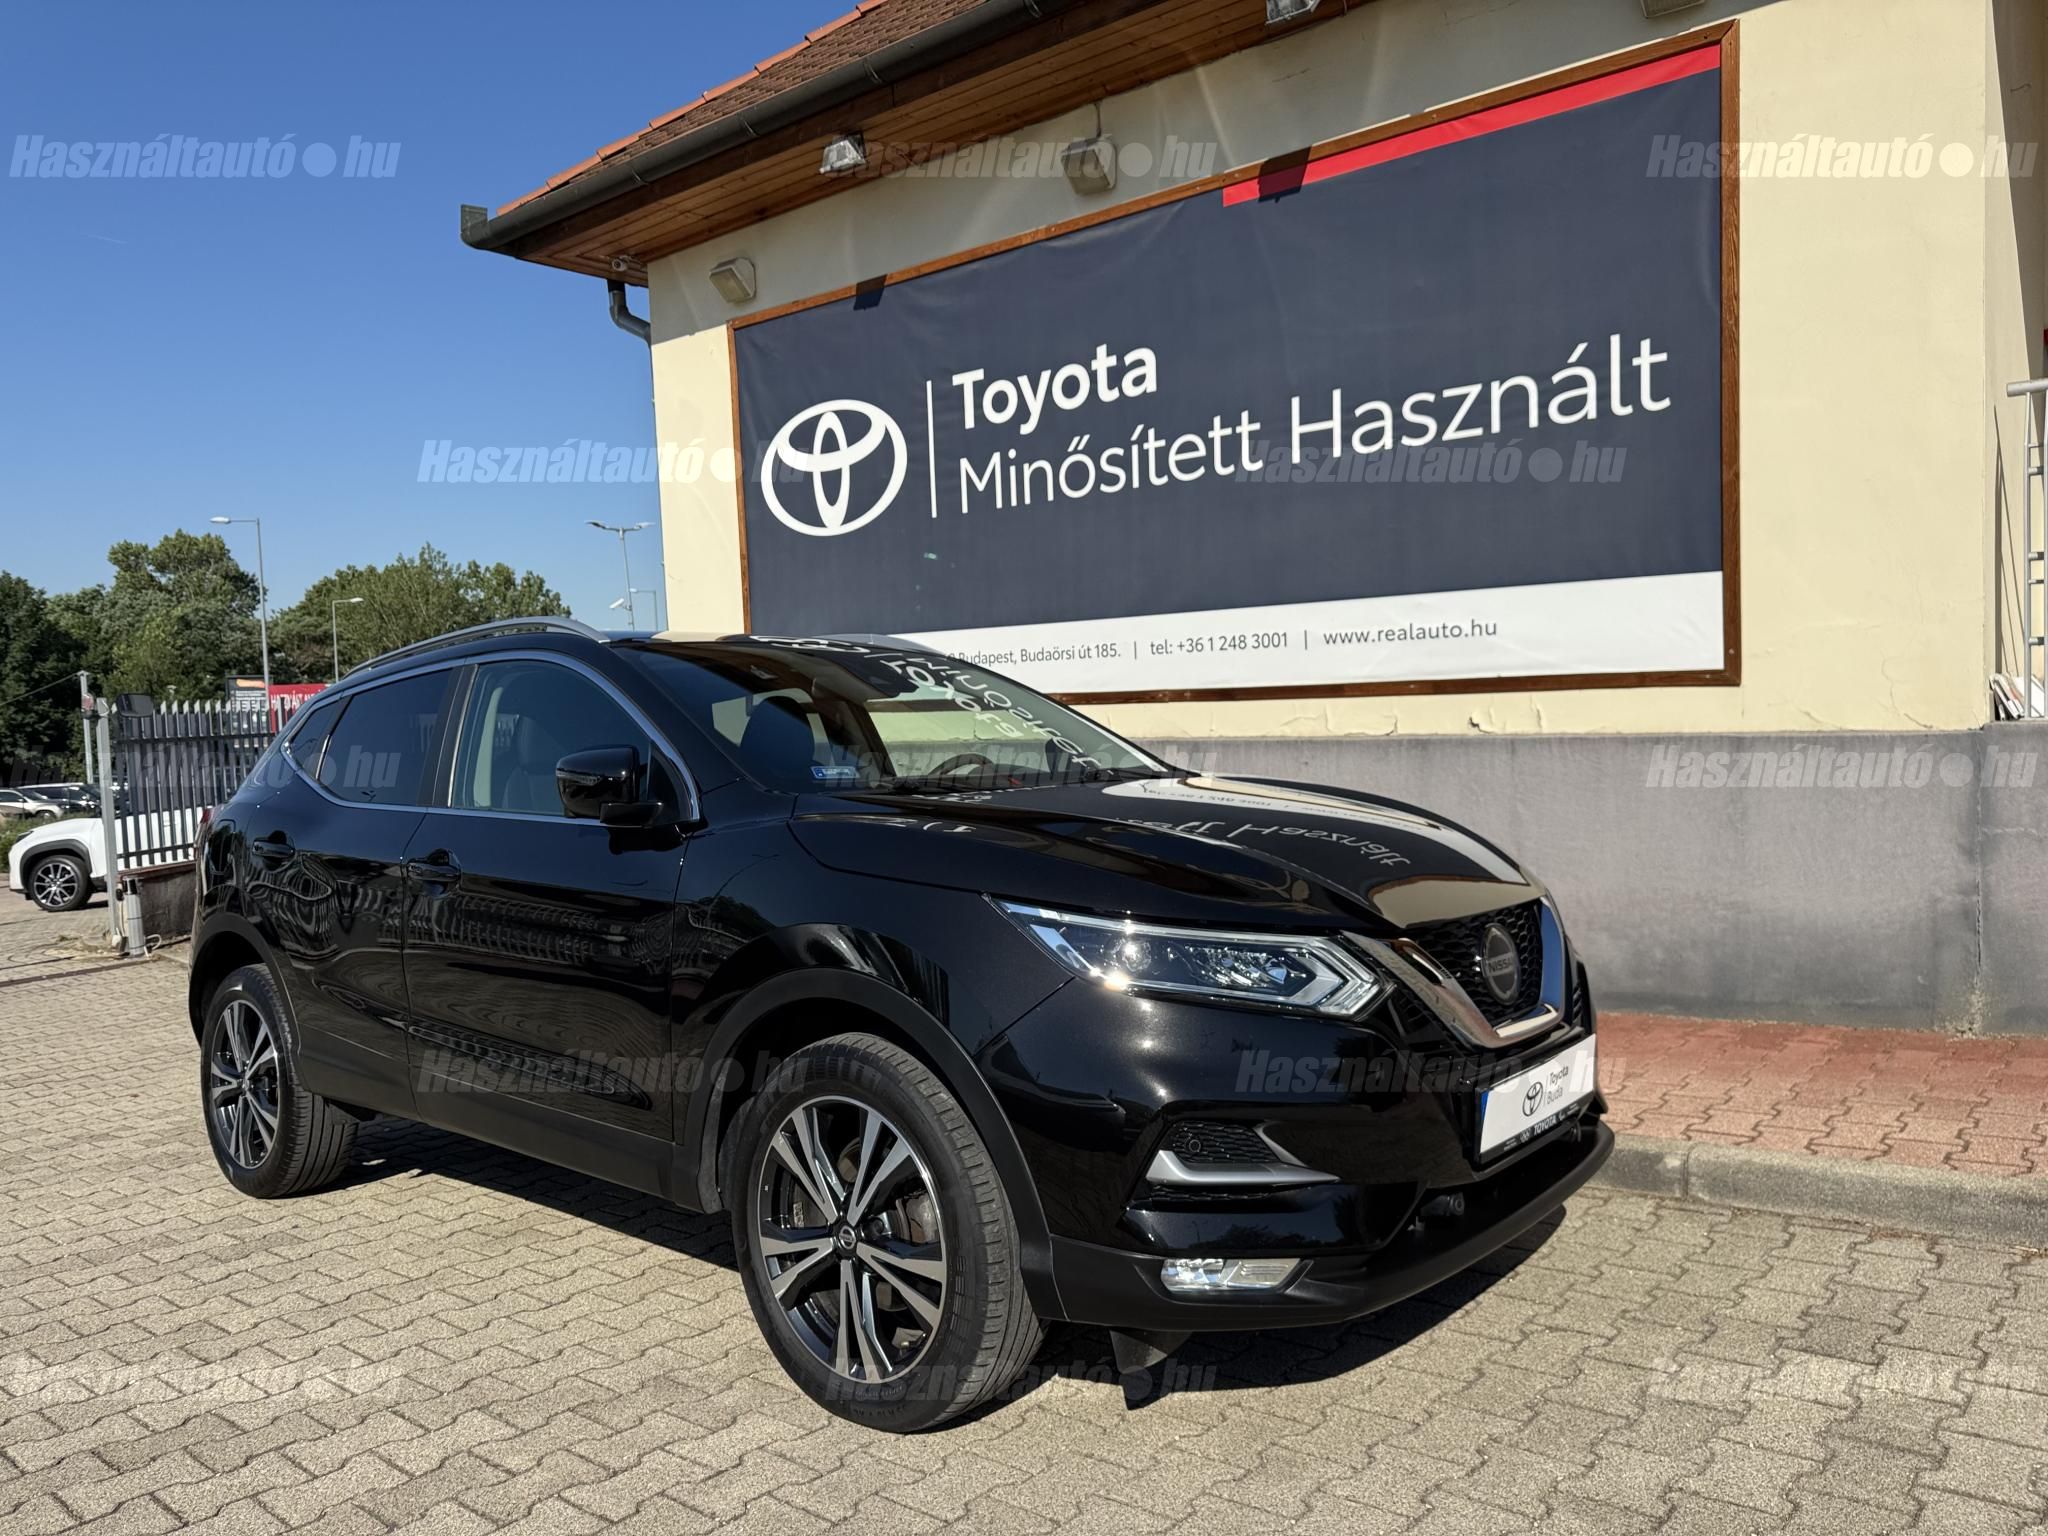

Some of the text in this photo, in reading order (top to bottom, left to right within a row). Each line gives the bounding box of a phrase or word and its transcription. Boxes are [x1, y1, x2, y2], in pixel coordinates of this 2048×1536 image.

[952, 343, 1157, 435] Toyota
[959, 334, 1671, 514] Minősített Használt
[1020, 646, 1074, 663] Budaörsi
[1078, 645, 1092, 660] út
[1095, 643, 1121, 658] 185.
[1150, 640, 1173, 656] tel:
[1219, 634, 1248, 651] 248
[1252, 632, 1288, 649] 3001
[1323, 619, 1497, 646] www.realauto.hu
[1549, 1065, 1569, 1085] Toyota
[1534, 1114, 1558, 1136] TOYOTA
